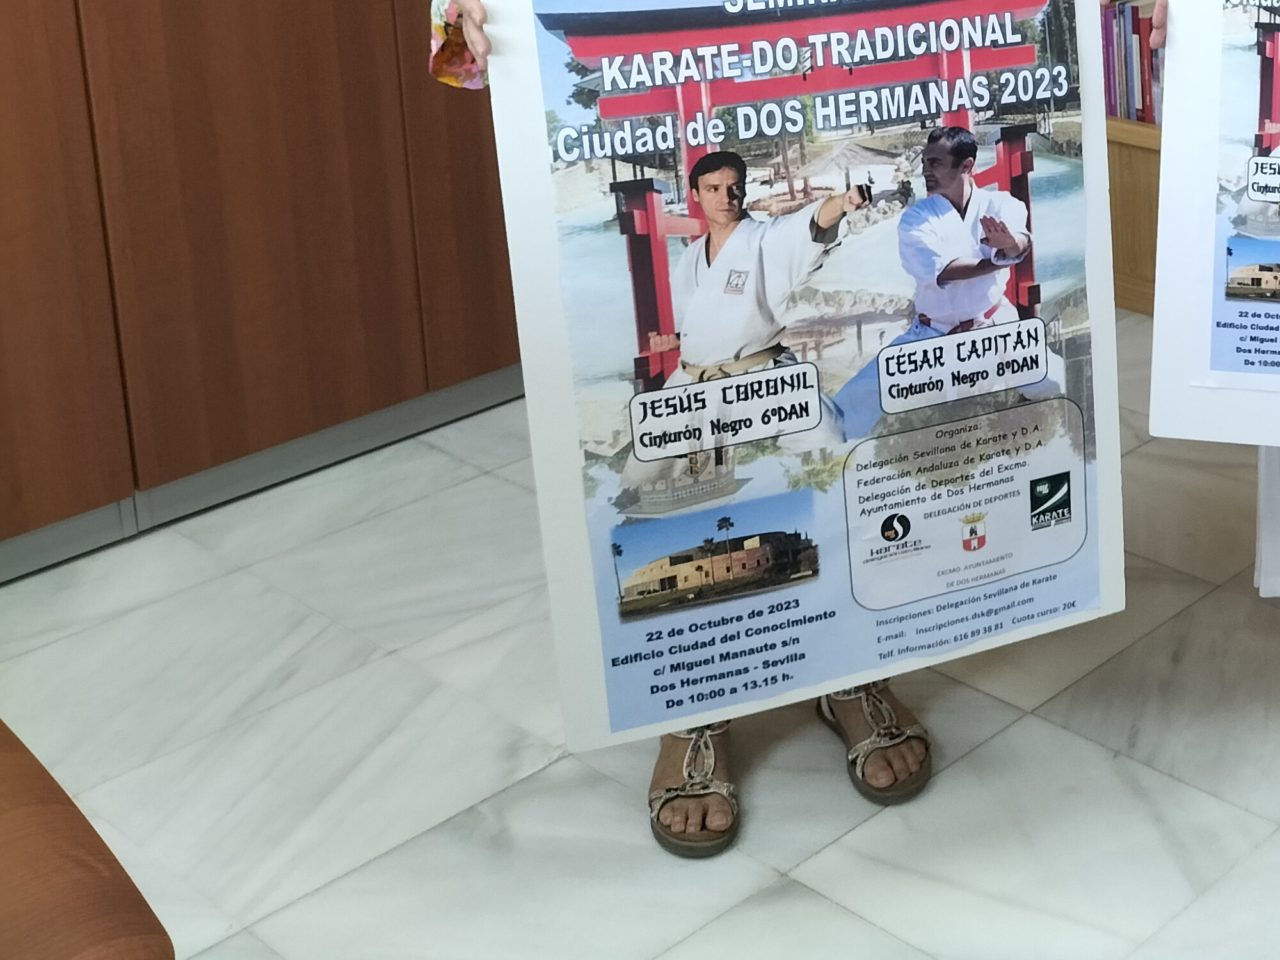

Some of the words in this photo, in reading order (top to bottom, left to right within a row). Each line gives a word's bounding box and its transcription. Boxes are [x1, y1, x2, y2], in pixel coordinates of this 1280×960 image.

[602, 37, 798, 91] KARATE-DO
[808, 13, 1022, 66] TRADICIONAL
[557, 116, 675, 161] Ciudad
[686, 107, 726, 146] de
[736, 100, 804, 139] DOS
[815, 76, 990, 128] HERMANAS
[1000, 65, 1068, 104] 2023
[1216, 321, 1248, 330] Edificio
[1250, 323, 1280, 331] Ciudad
[1249, 335, 1277, 344] Miguel
[885, 346, 945, 377] CÉSAR
[956, 327, 1039, 362] CAPITÁN
[1236, 346, 1252, 354] Dos
[639, 390, 707, 424] JESÚS
[721, 371, 814, 405] CORONIL
[888, 376, 944, 400] Cinturón
[951, 370, 989, 387] Negro
[996, 354, 1039, 377] 8ºDAN
[639, 424, 702, 448] Cinturón
[709, 417, 753, 436] Negro
[761, 401, 809, 425] 6ºDAN
[935, 424, 982, 439] Organiza:
[856, 454, 909, 472] Delegación
[913, 445, 956, 460] Sevillana
[960, 440, 972, 450] de
[976, 433, 1008, 447] Karate
[1011, 431, 1017, 440] y
[1021, 424, 1042, 436] D.A.
[857, 470, 911, 488] Federación
[915, 460, 959, 476] Andaluza
[963, 456, 975, 465] de
[979, 448, 1011, 462] Karate
[1015, 446, 1021, 455] y
[1024, 440, 1045, 451] D.A.
[858, 485, 911, 504] Delegación
[915, 482, 926, 491] de
[931, 473, 975, 489] Deportes
[979, 467, 993, 477] del
[997, 461, 1029, 473] Excmo.
[860, 496, 926, 517] Ayuntamiento
[930, 492, 942, 501] de
[947, 488, 964, 498] Dos
[968, 476, 1014, 492] Hermanas
[923, 503, 971, 519] DELEGACIÓN
[973, 499, 982, 508] DE
[984, 490, 1021, 505] DEPORTES
[1032, 508, 1070, 525] KARATE
[611, 650, 664, 667] Edificio
[668, 637, 716, 655] Ciudad
[720, 631, 740, 644] del
[745, 611, 836, 638] Conocimiento
[646, 630, 663, 642] 22
[667, 628, 684, 638] de
[688, 615, 744, 633] Octubre
[747, 609, 764, 620] de
[768, 599, 800, 615] 2023
[650, 683, 676, 695] Dos
[680, 667, 750, 688] Hermanas
[762, 653, 806, 669] Sevilla
[653, 665, 666, 676] c/
[670, 655, 715, 673] Miguel
[719, 642, 777, 662] Manaute
[781, 637, 800, 648] s/n
[666, 699, 684, 709] De
[688, 688, 725, 703] 10:00
[729, 687, 737, 695] a
[742, 675, 778, 691] 13.15
[782, 673, 793, 682] h.
